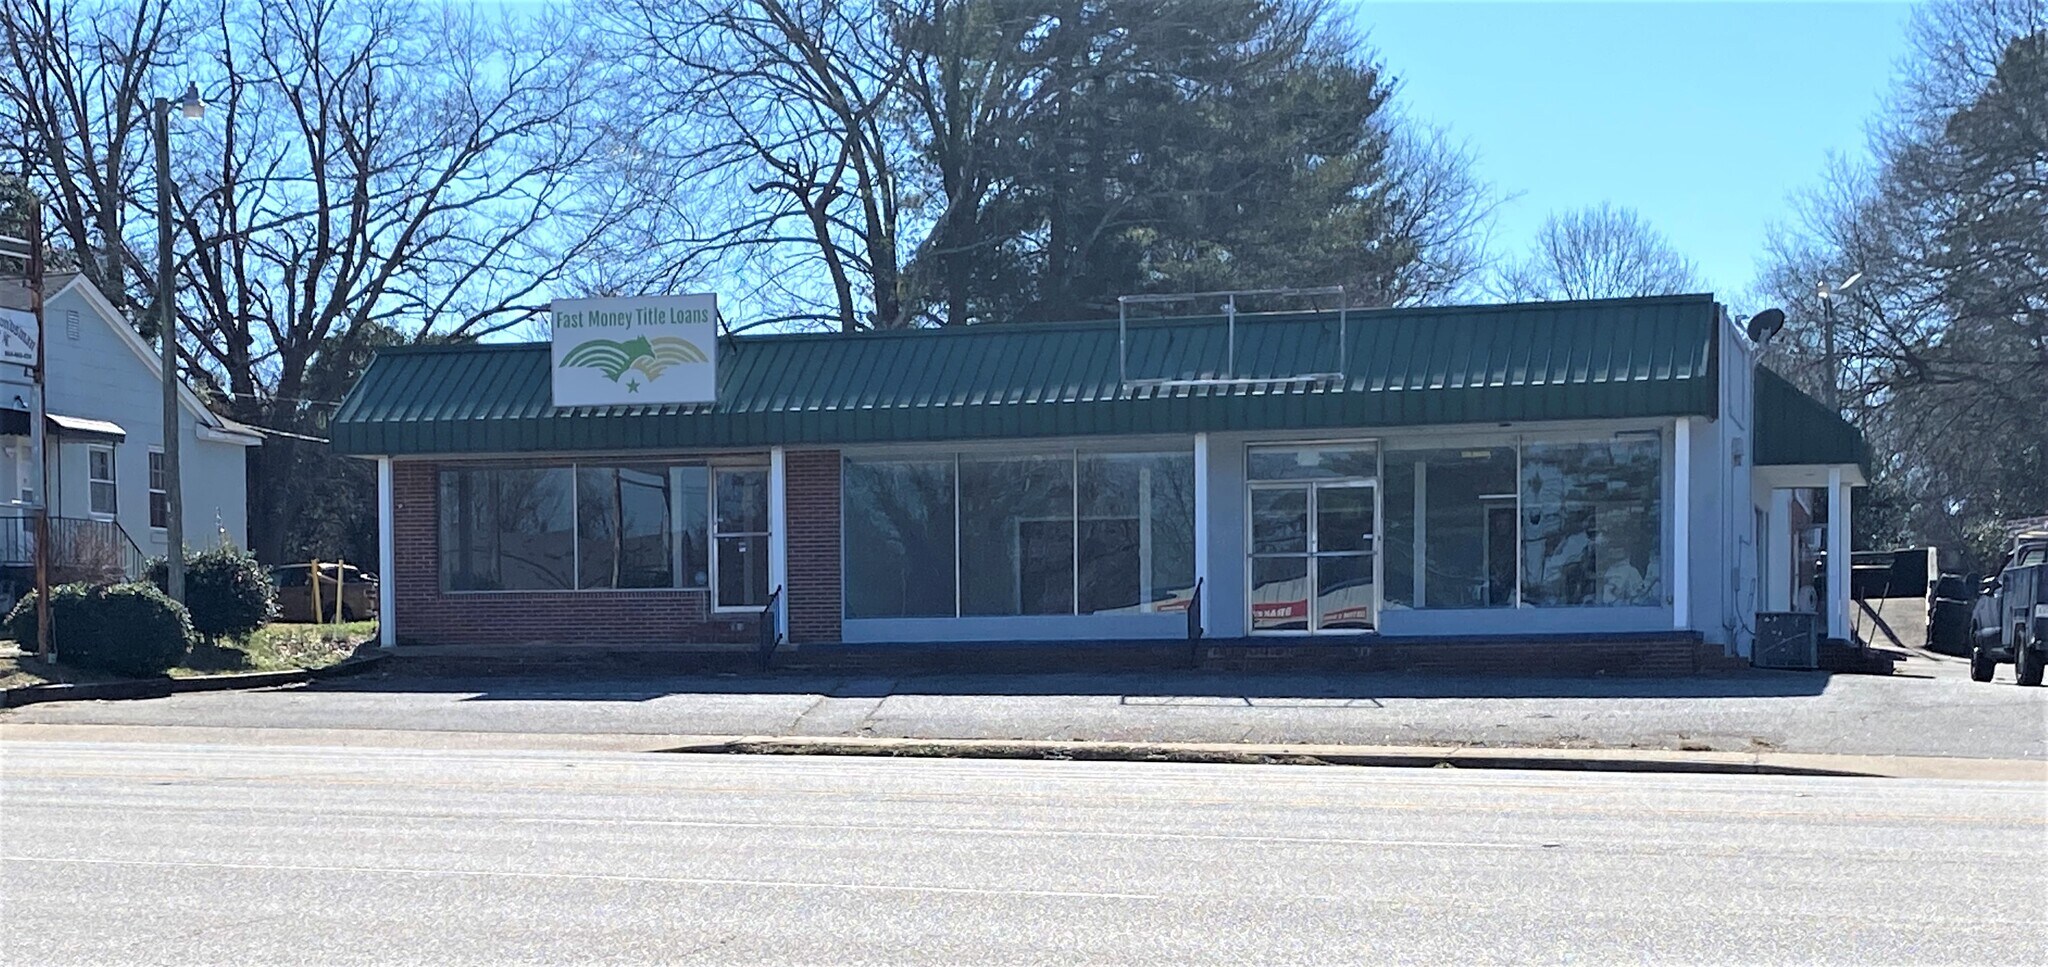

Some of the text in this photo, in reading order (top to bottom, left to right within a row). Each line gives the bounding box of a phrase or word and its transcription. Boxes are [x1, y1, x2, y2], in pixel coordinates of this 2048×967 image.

[556, 306, 709, 330] Fast Money Title Loans
